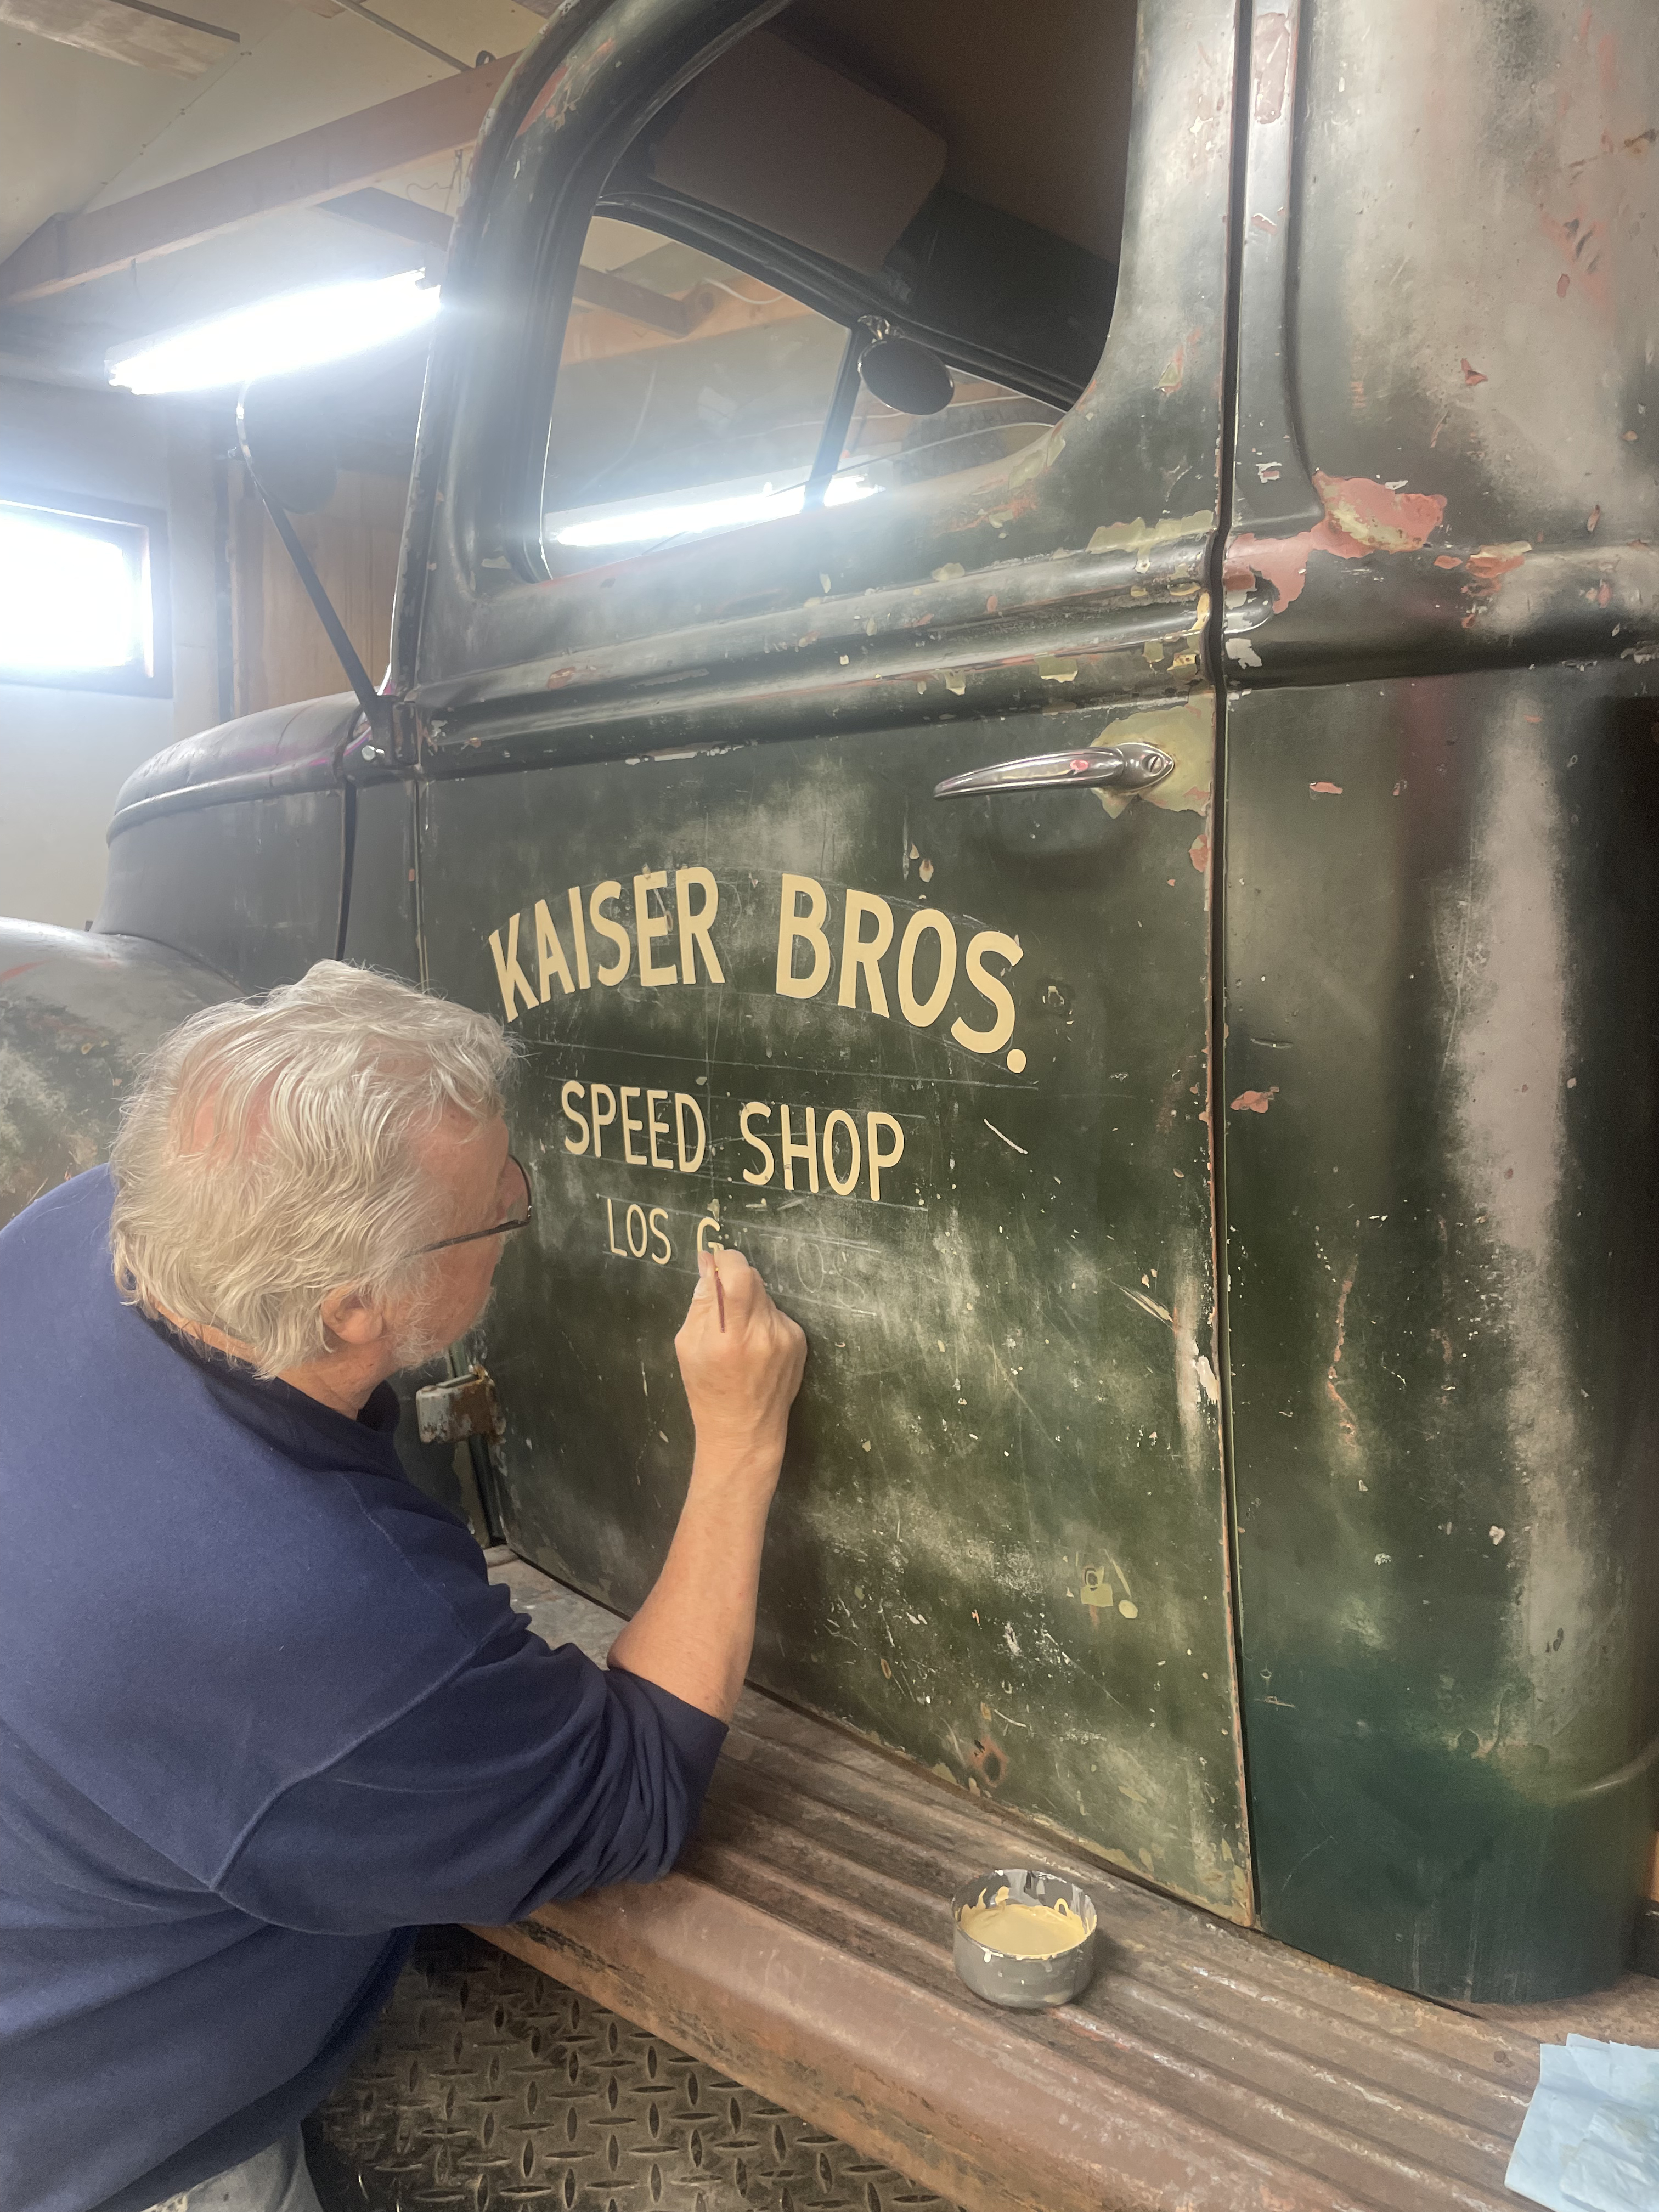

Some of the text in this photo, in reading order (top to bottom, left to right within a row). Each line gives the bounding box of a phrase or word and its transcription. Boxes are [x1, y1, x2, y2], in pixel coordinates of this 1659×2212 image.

[488, 866, 1026, 1074] KAISER BROS.
[561, 1080, 905, 1202] SPEED SHOP
[606, 1198, 672, 1265] LOS
